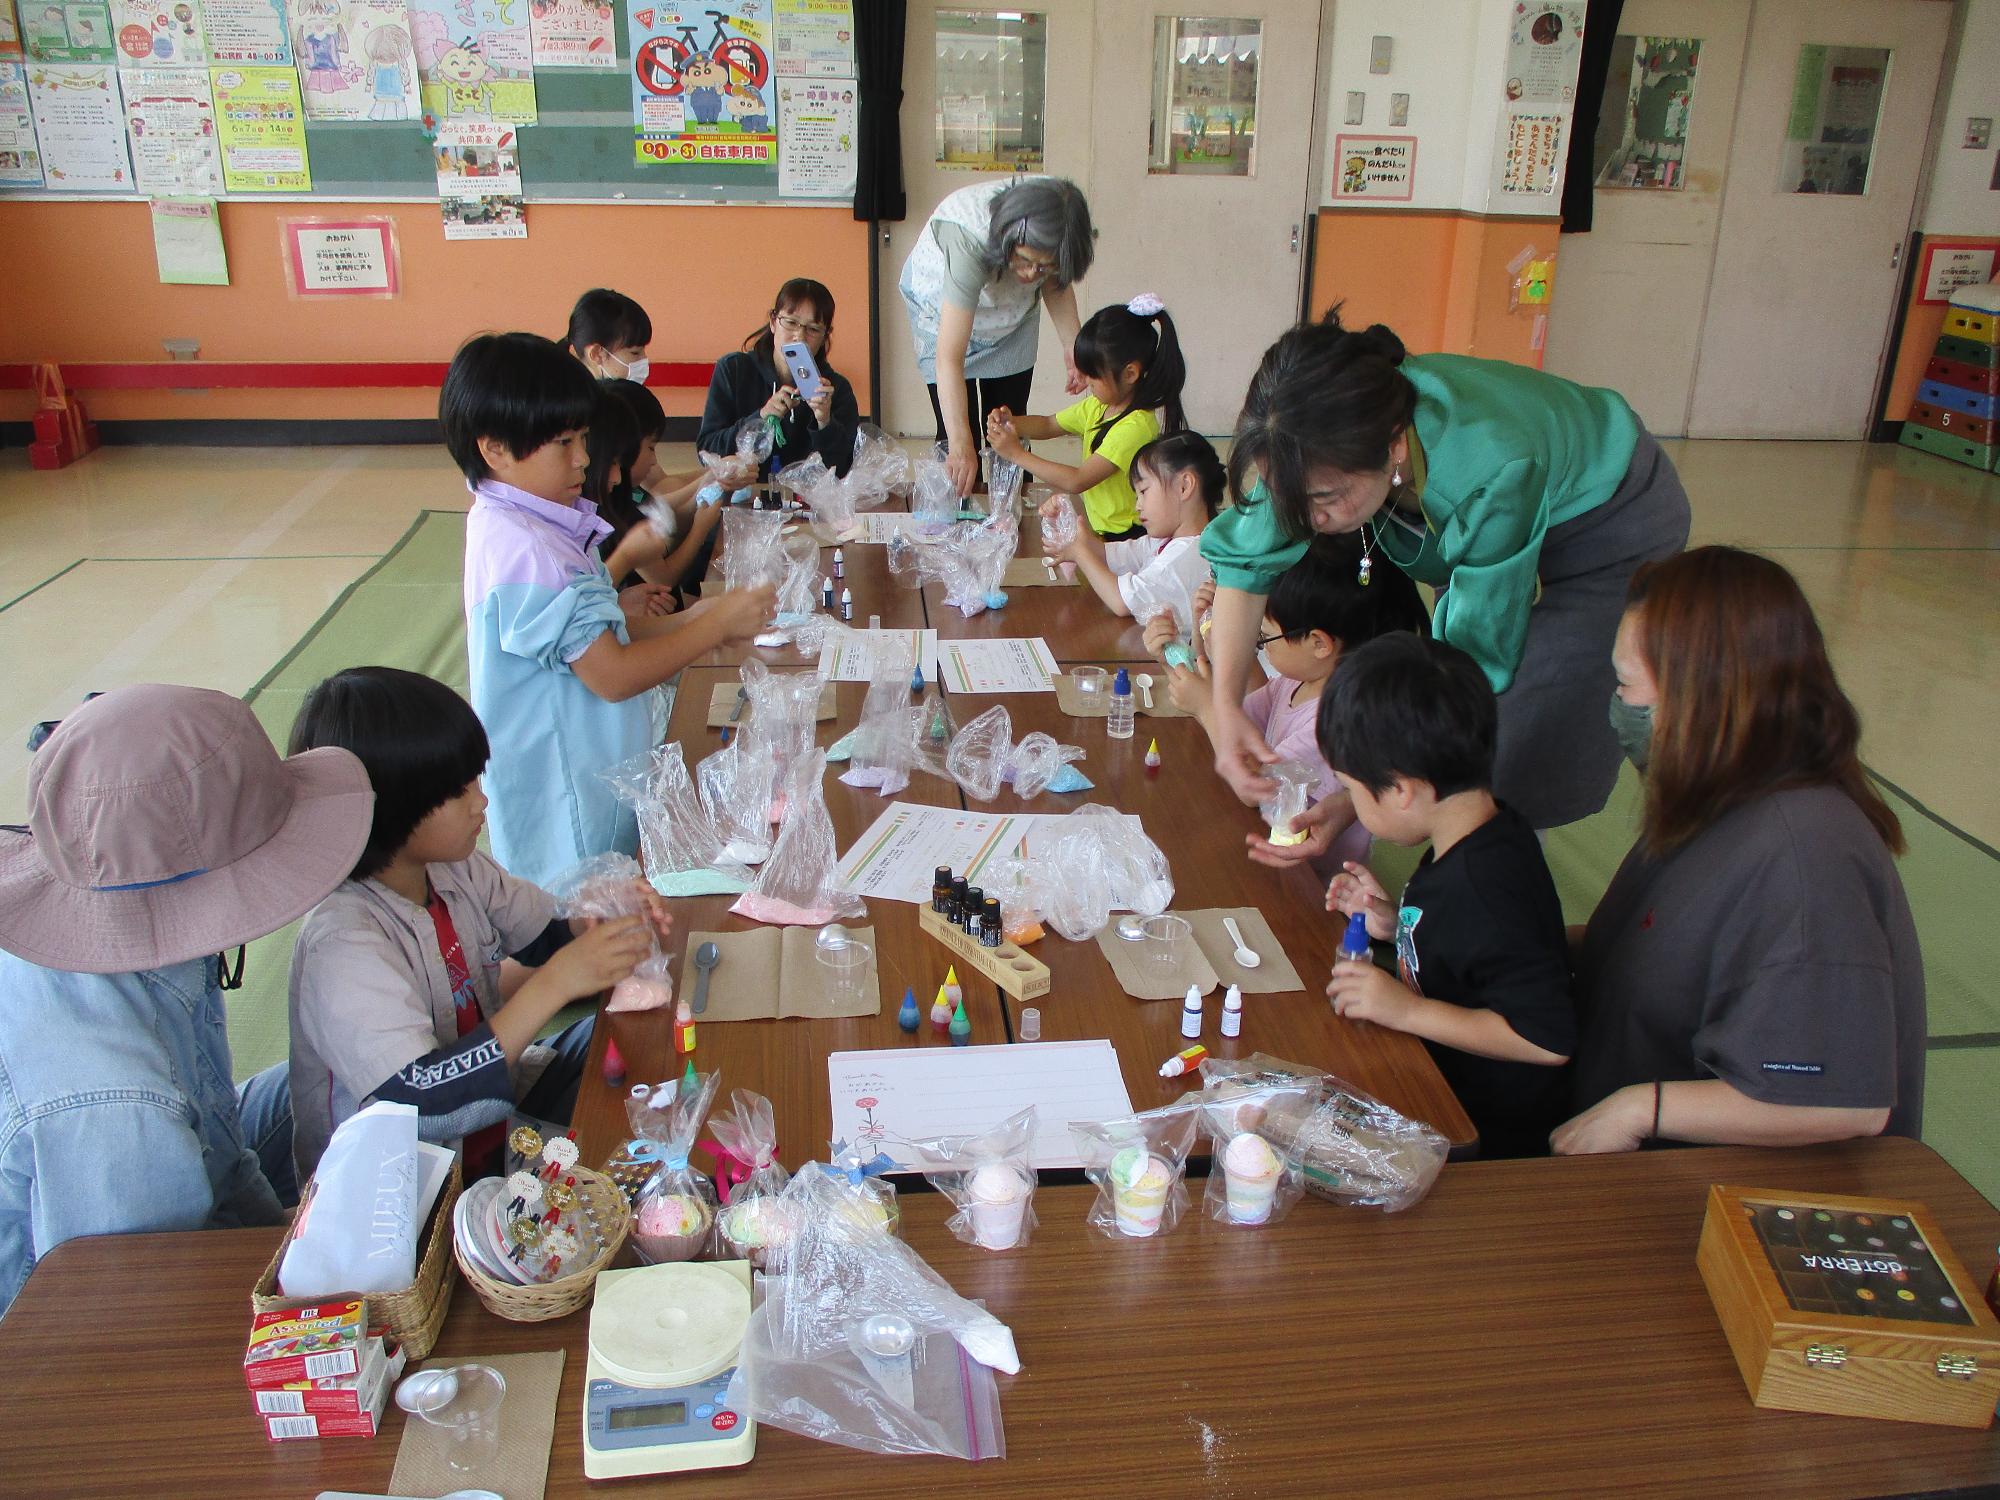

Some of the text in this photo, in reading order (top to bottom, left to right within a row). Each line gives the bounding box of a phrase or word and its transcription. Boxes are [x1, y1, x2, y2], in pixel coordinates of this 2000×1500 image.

[701, 144, 768, 158] 自転車月間
[1942, 412, 1951, 426] 5
[367, 1151, 410, 1259] MIEUX
[269, 1316, 343, 1336] Assorted
